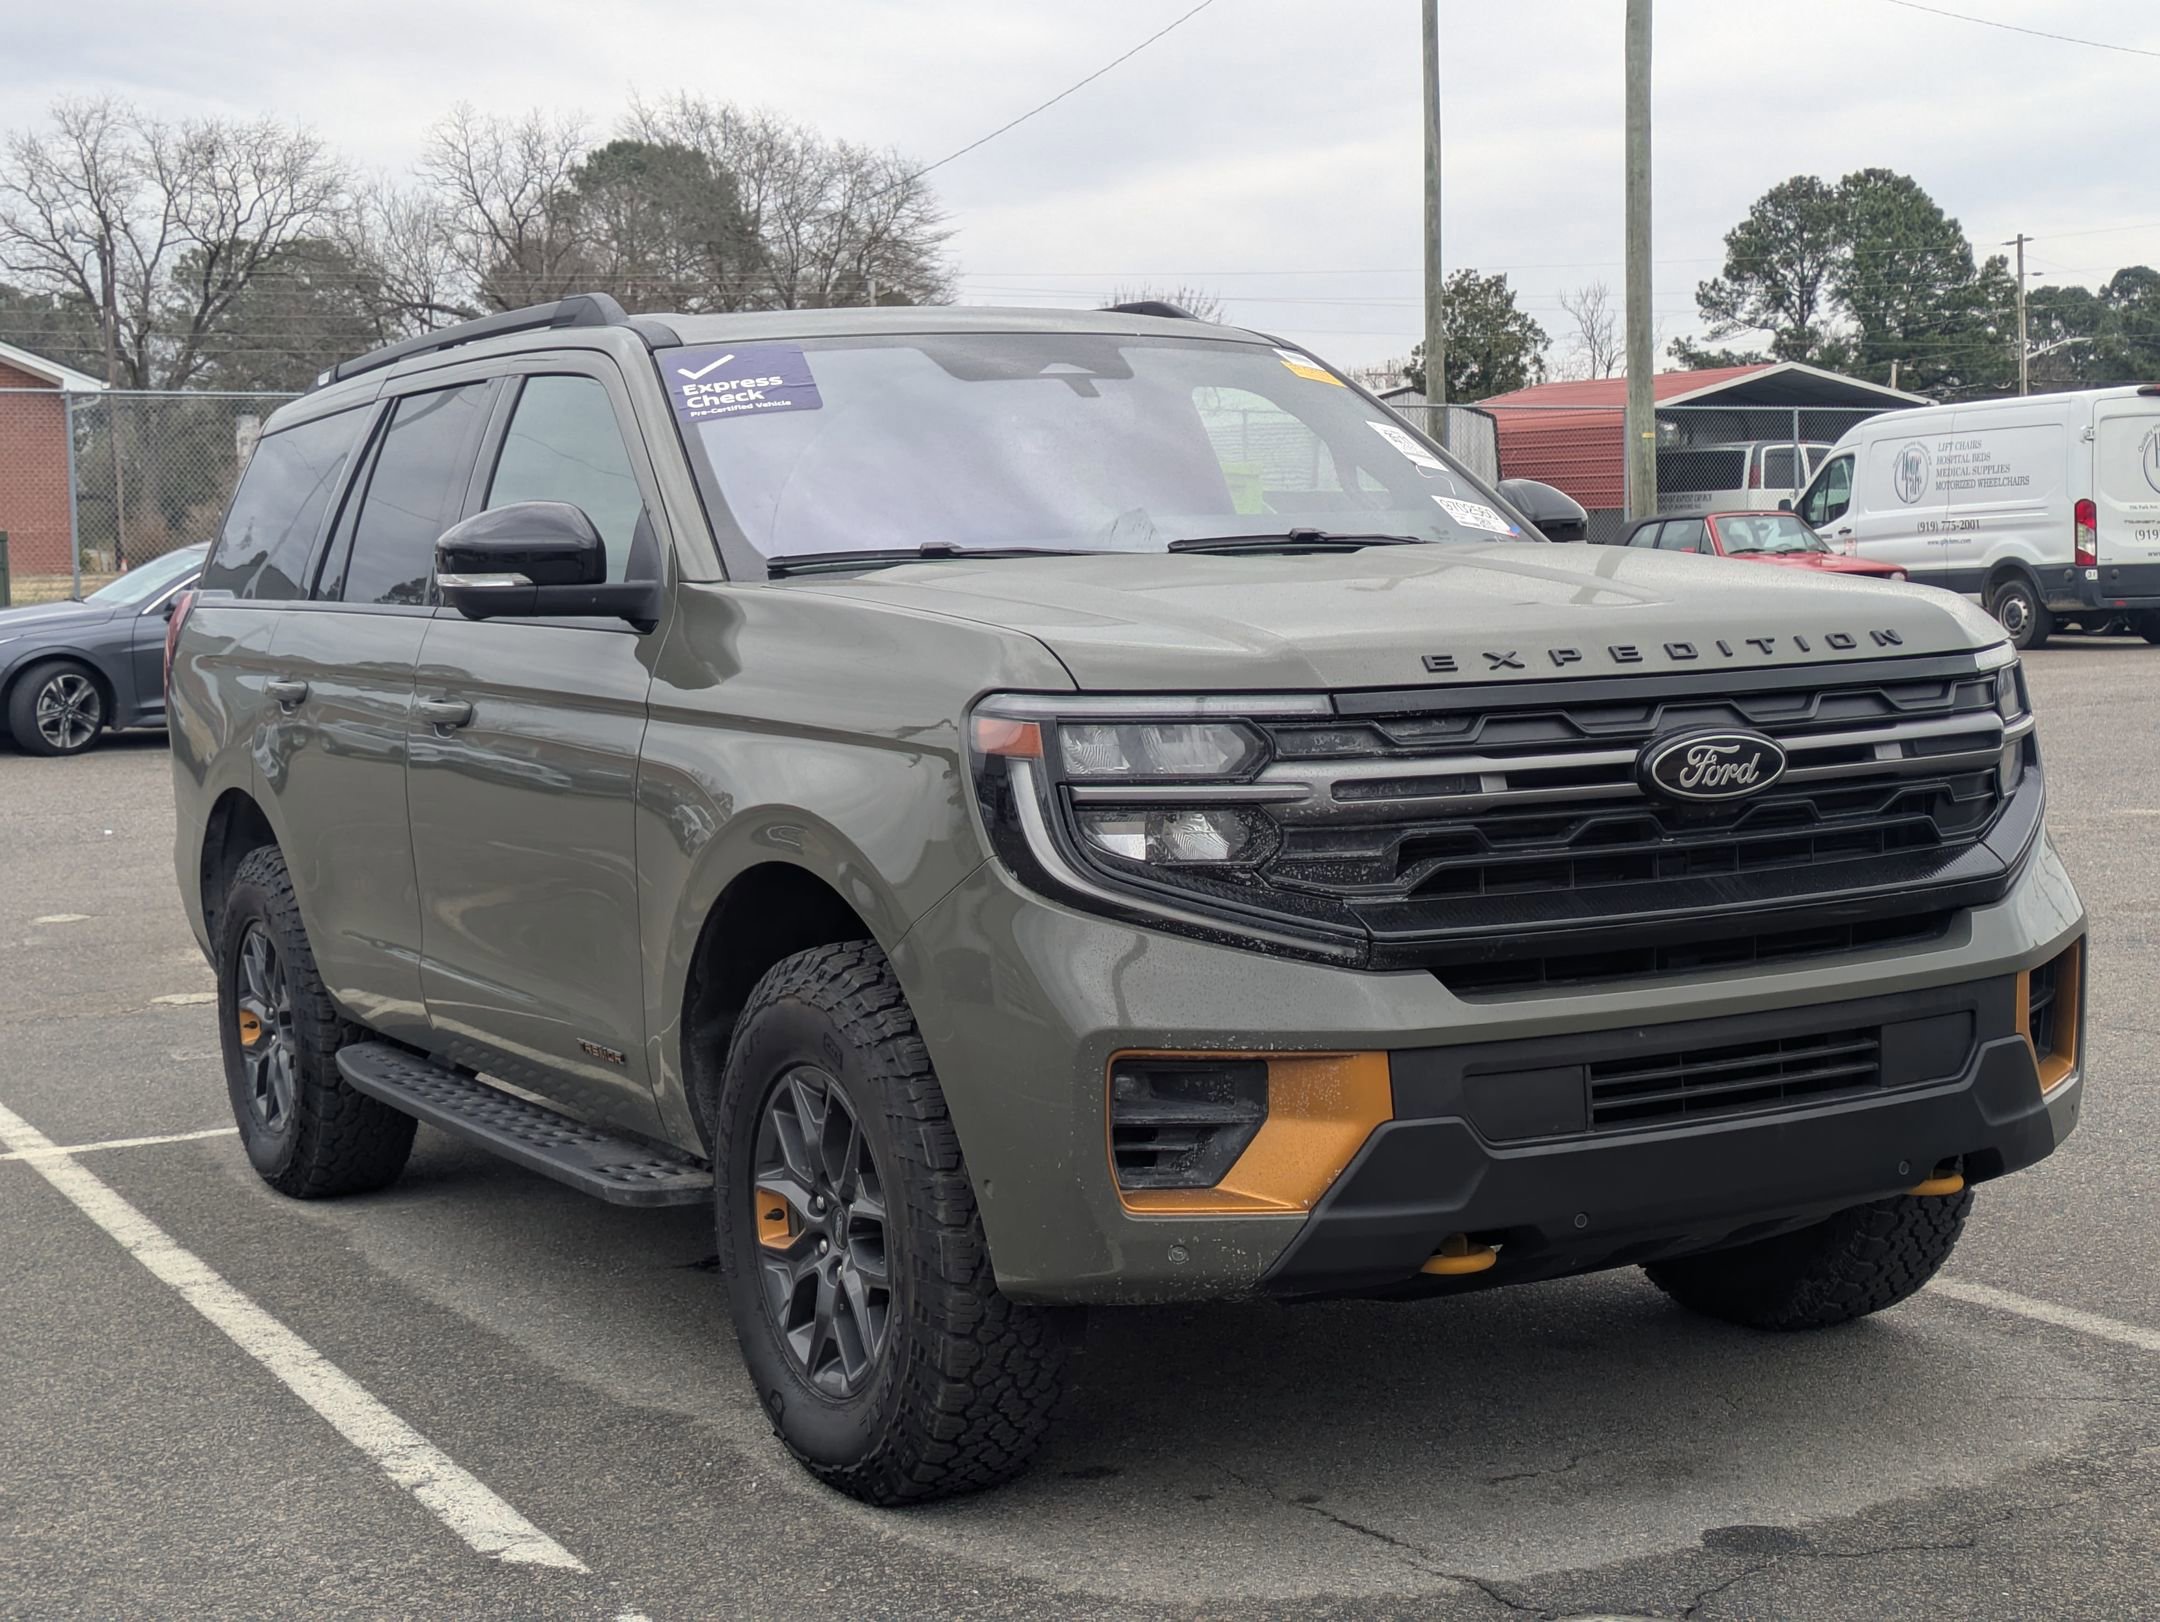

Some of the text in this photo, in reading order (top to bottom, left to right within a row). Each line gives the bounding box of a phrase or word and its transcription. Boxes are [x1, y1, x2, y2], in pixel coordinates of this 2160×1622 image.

[682, 376, 783, 396] Express
[687, 389, 765, 408] Check
[690, 400, 792, 417] Pre-Certified Vehicle
[1938, 440, 1982, 452] LIFT CHAIRS
[1936, 452, 1991, 465] HOSPITAL BEDS
[1936, 464, 2010, 478] MEDICAL SUPPLIES
[1936, 476, 2030, 491] MOTORIZED WHEELCHAIRS
[1917, 519, 1980, 534] (919) 775-2001
[1420, 628, 1904, 673] EXPEDITION
[1679, 744, 1762, 791] Ford
